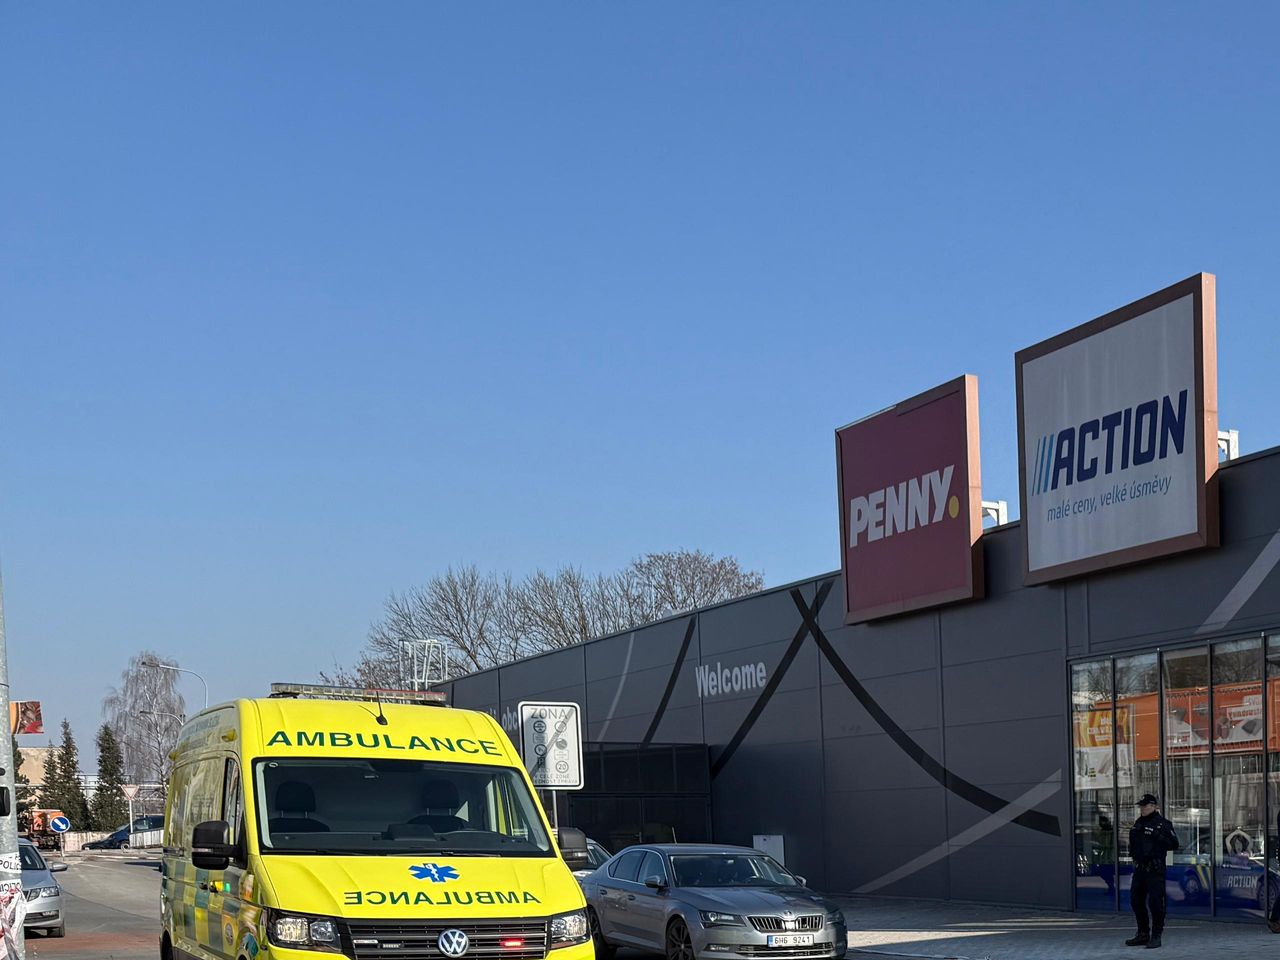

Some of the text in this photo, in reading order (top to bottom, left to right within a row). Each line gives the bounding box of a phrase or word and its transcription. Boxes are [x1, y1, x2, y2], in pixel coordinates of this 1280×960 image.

[1051, 389, 1188, 490] ACTION
[1047, 474, 1172, 523] malé ceny, velké úsměvy
[695, 661, 767, 698] Welcome
[530, 707, 569, 720] ZONA
[266, 731, 503, 756] AMBULANCE
[1227, 875, 1258, 888] ACTION
